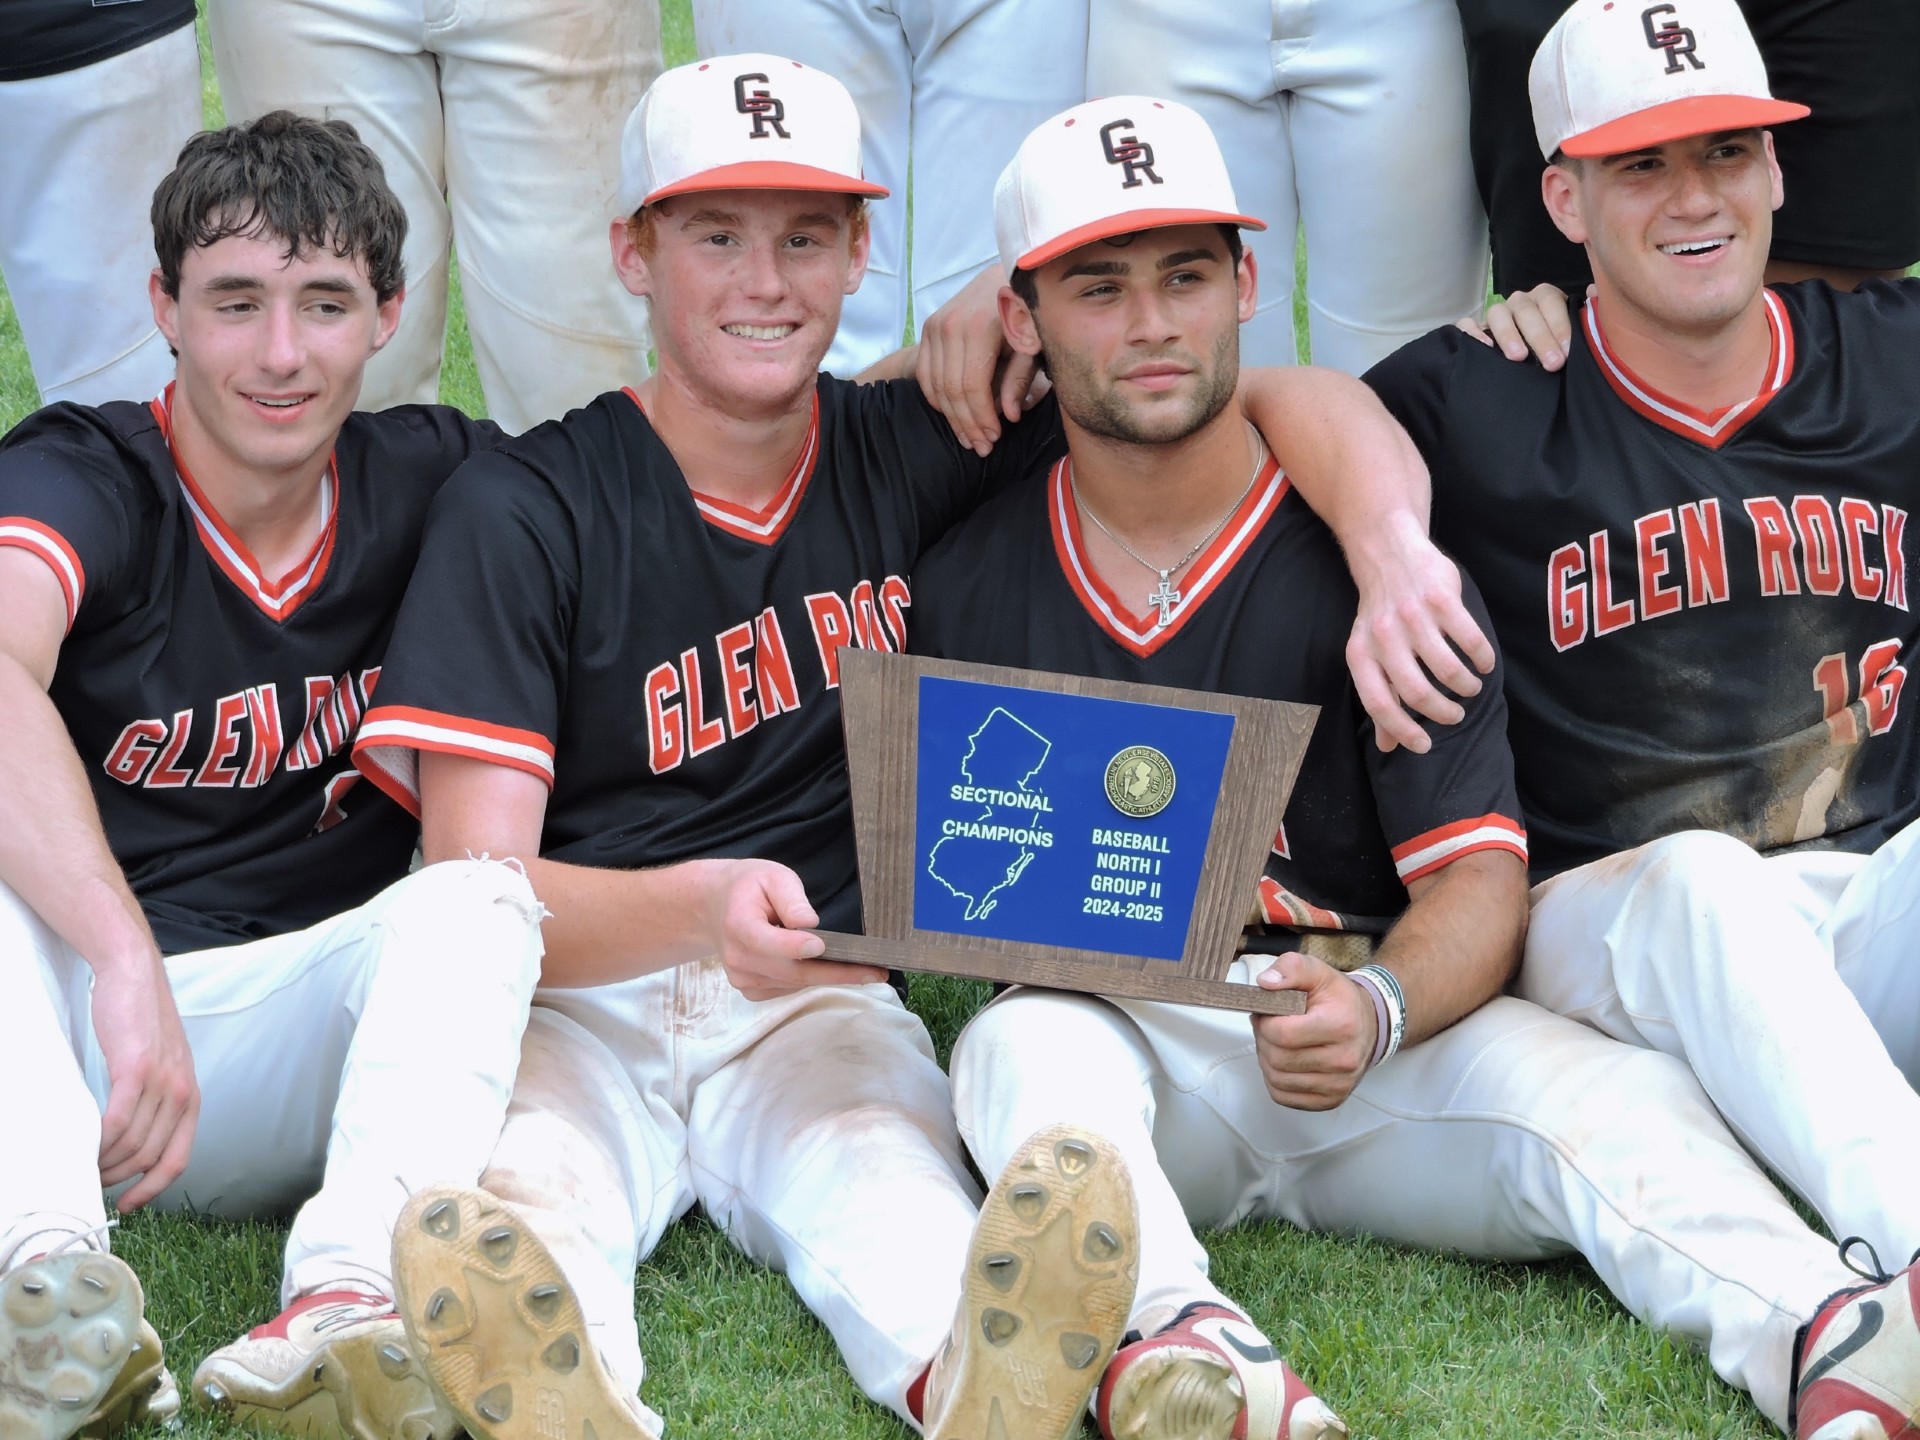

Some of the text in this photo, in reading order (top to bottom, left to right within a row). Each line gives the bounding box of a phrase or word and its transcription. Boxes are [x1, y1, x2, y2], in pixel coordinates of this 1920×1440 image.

[1641, 3, 1705, 75] GR
[734, 73, 791, 139] GR
[1100, 118, 1163, 189] GR
[1548, 495, 1909, 652] GLEN ROCK
[645, 606, 800, 774] GLEN
[103, 683, 284, 788] GLEN
[950, 784, 1053, 812] SECTIONAL
[942, 820, 1053, 847] CHAMPIONS
[1092, 829, 1170, 853] BASEBALL
[1091, 875, 1161, 898] GROUP II
[1097, 852, 1161, 875] NORTH I
[1083, 897, 1163, 922] 2024-2025
